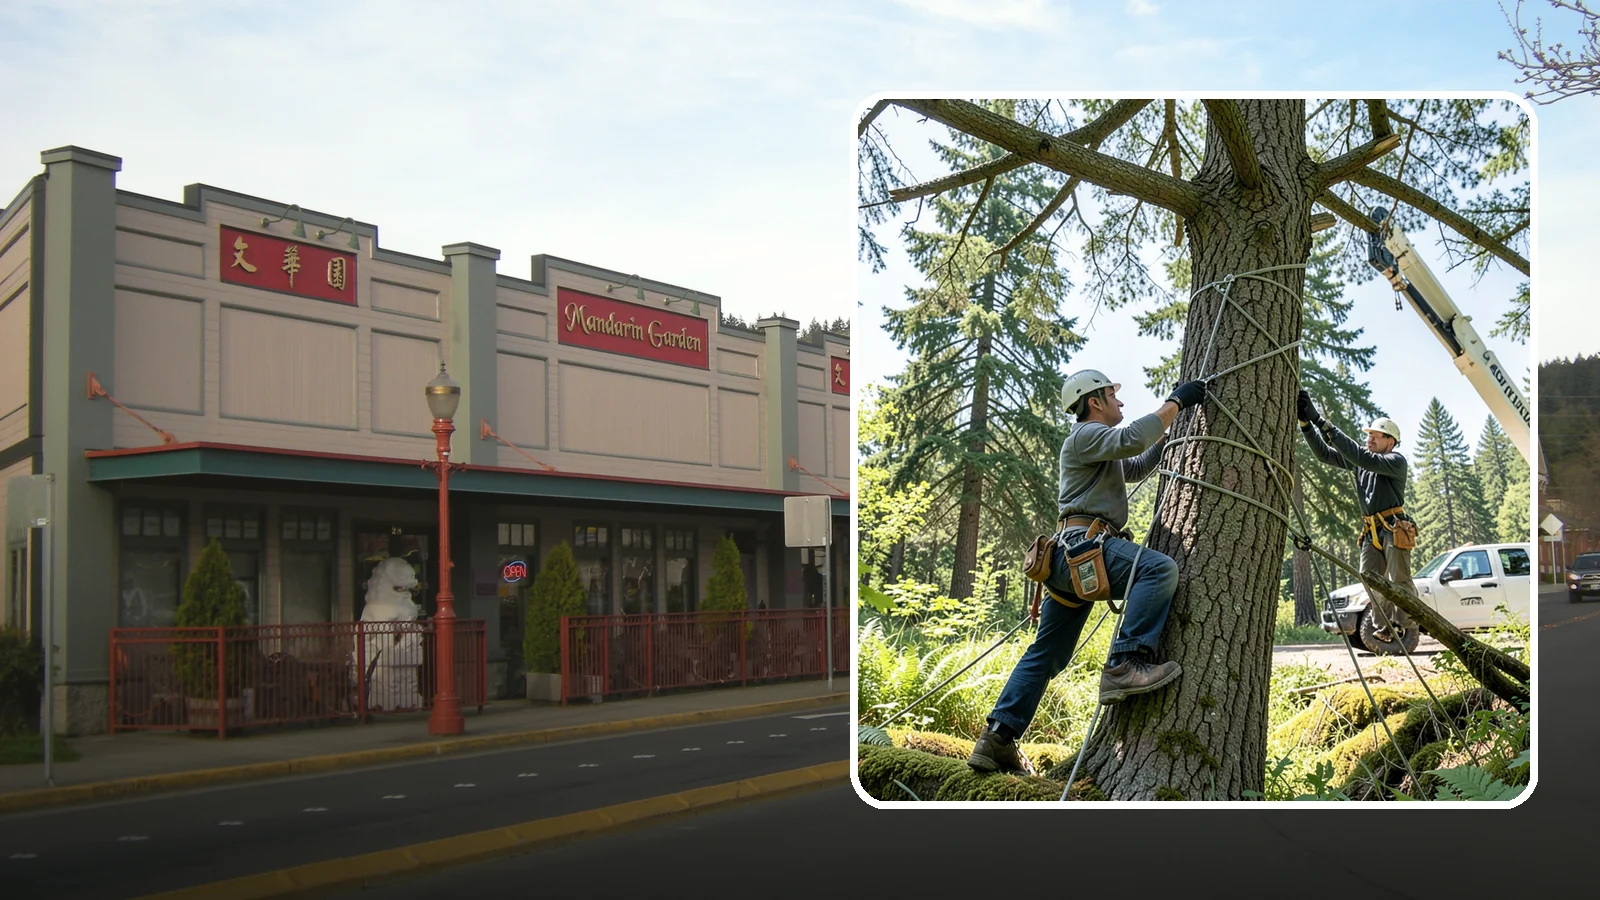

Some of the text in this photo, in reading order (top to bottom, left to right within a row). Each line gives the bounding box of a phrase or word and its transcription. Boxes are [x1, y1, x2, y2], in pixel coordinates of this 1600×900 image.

[230, 236, 346, 291] 文華園
[564, 302, 702, 352] Mandarin Garden
[503, 565, 527, 578] OPEN
